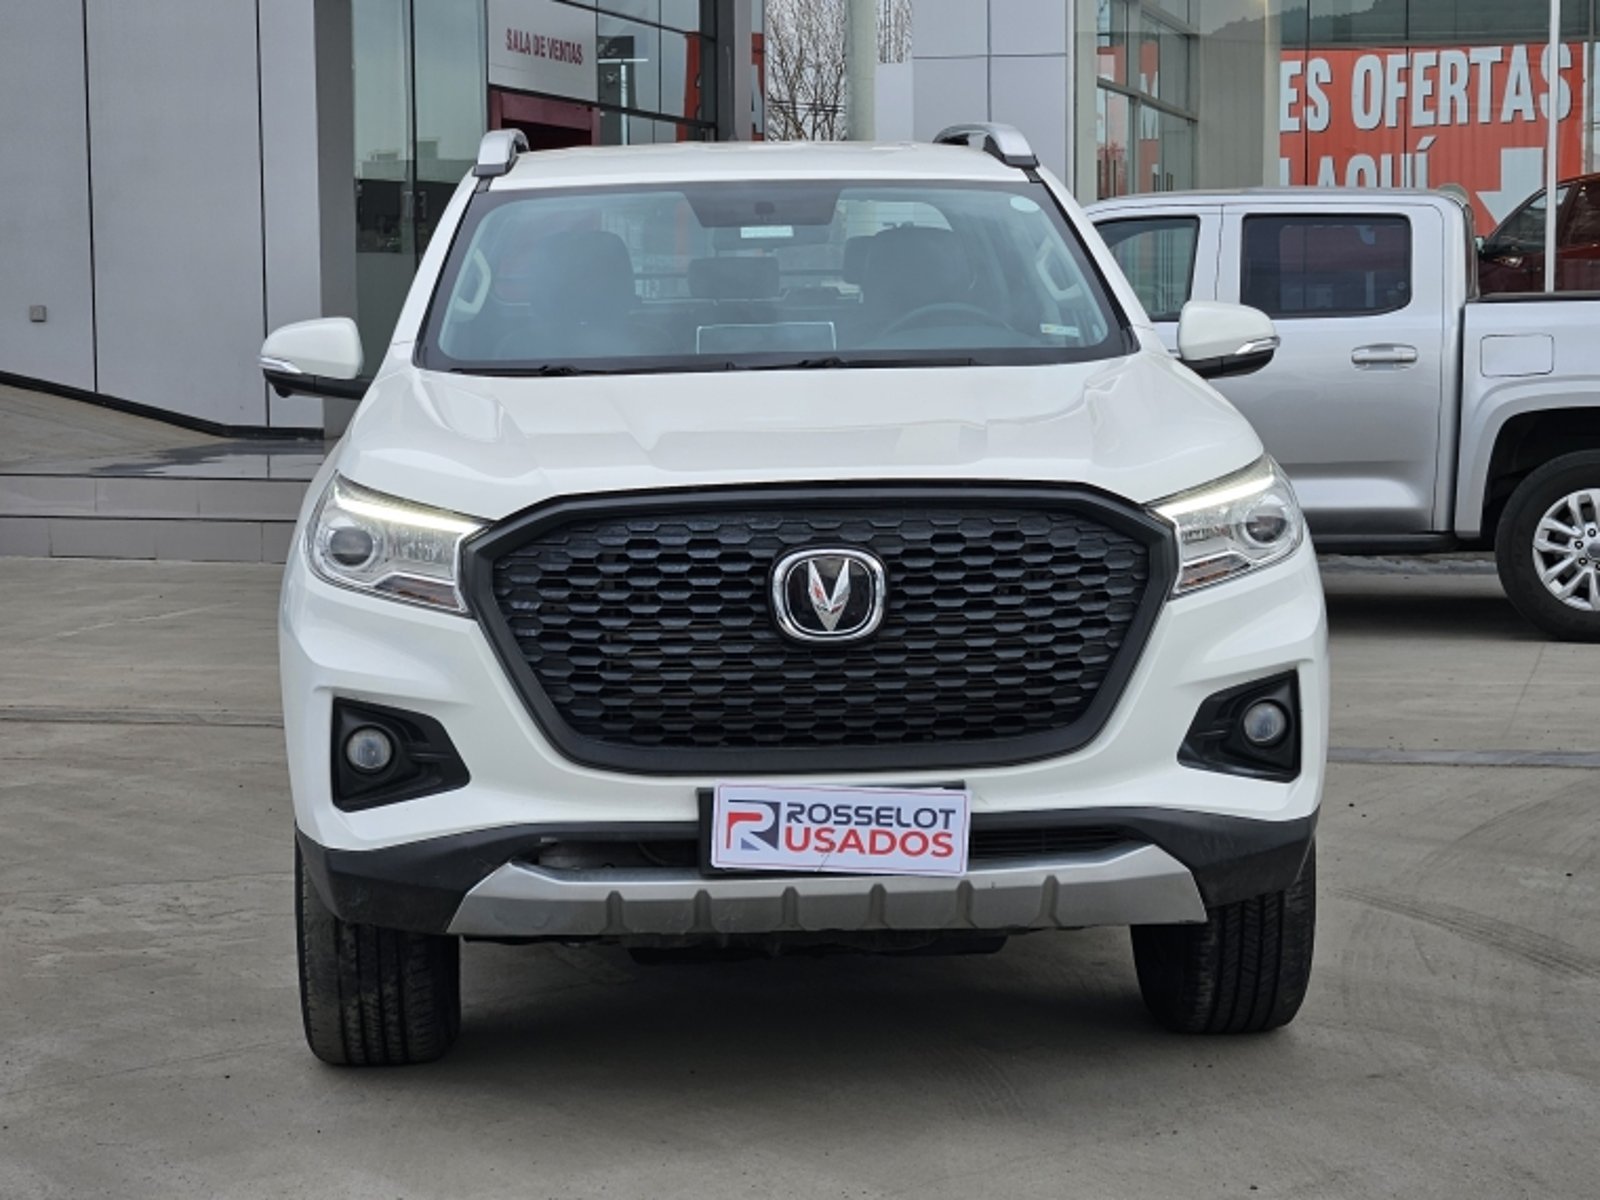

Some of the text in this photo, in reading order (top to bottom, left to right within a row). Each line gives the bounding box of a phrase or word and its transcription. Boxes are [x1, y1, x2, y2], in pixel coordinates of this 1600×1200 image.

[506, 28, 584, 66] SALA DE VENTAS
[1351, 43, 1572, 130] OFERTAS
[786, 802, 956, 830] ROSSELOT
[784, 826, 954, 858] USADOS
